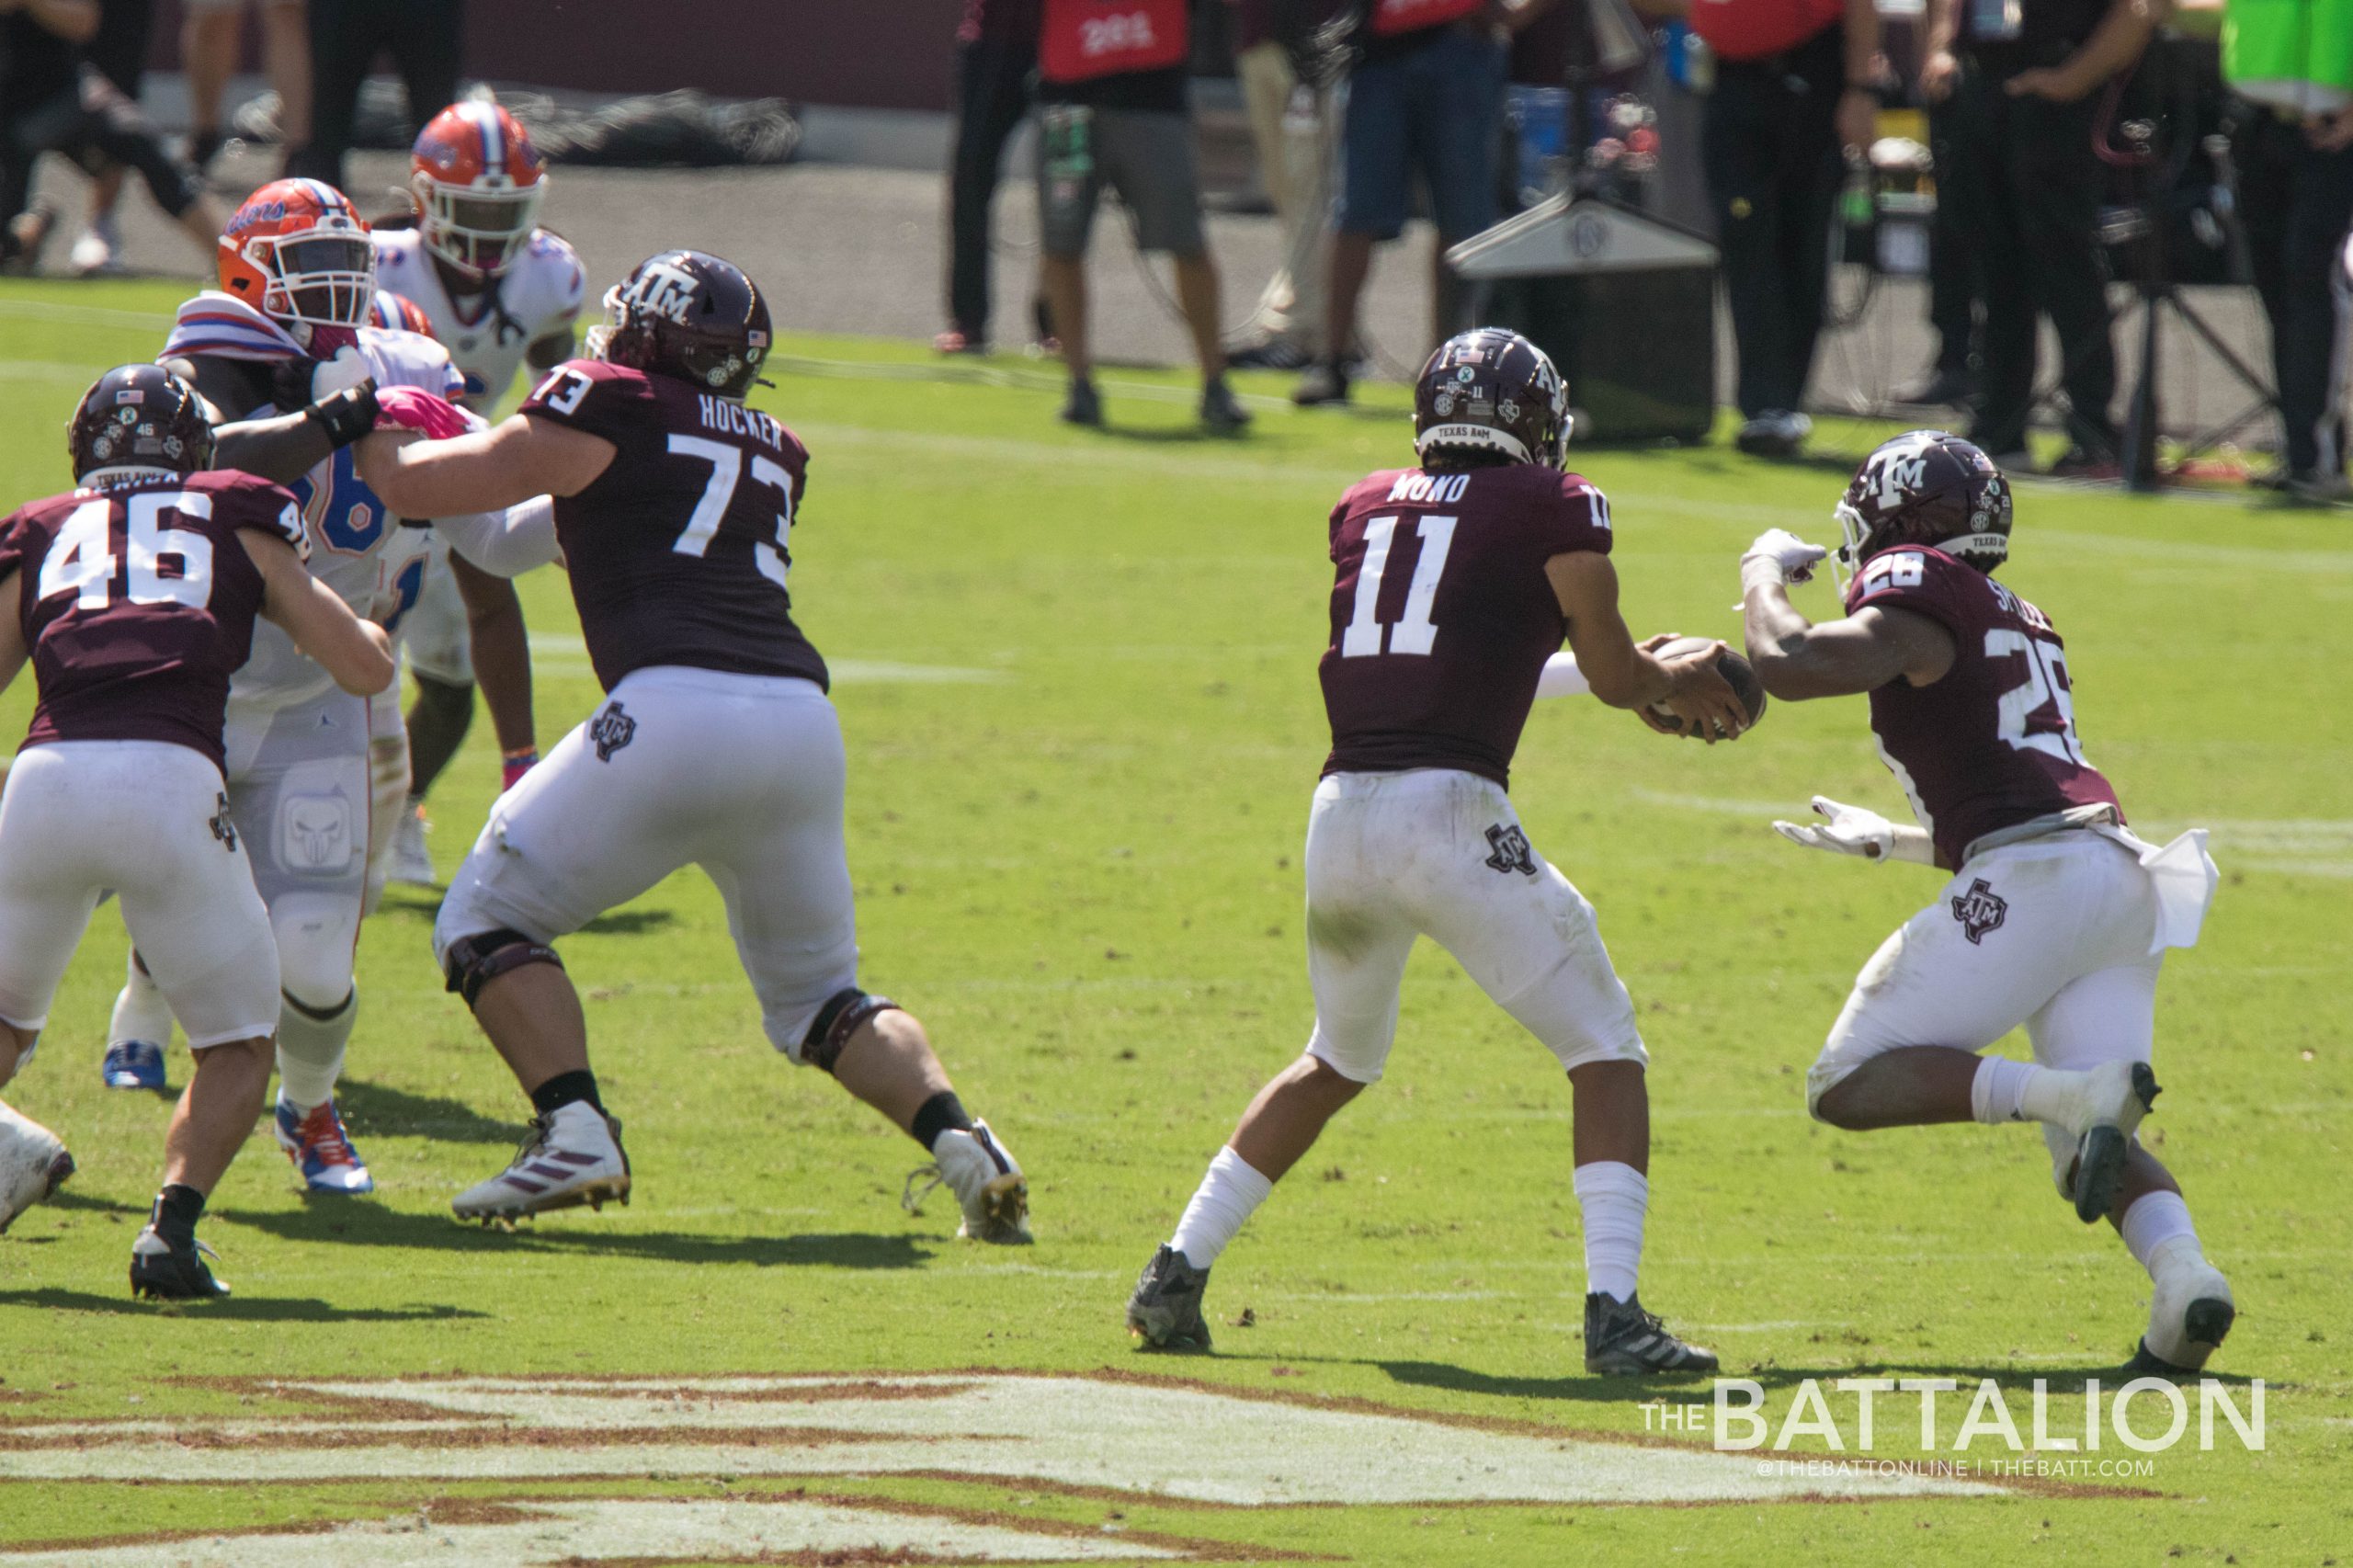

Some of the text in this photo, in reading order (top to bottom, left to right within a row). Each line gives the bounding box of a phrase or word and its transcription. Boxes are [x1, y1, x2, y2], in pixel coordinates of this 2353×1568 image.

[532, 365, 593, 415] 73
[1472, 386, 1483, 399] 11
[136, 423, 154, 436] 46
[699, 393, 782, 451] HOCKER
[1438, 426, 1491, 439] TEXAS A&M
[666, 434, 793, 590] 73
[1387, 473, 1470, 504] MOND
[1579, 484, 1612, 530] 11
[39, 491, 212, 610] 46
[1863, 551, 1925, 597] 28
[1342, 516, 1458, 659] 11
[1984, 629, 2098, 771] 28
